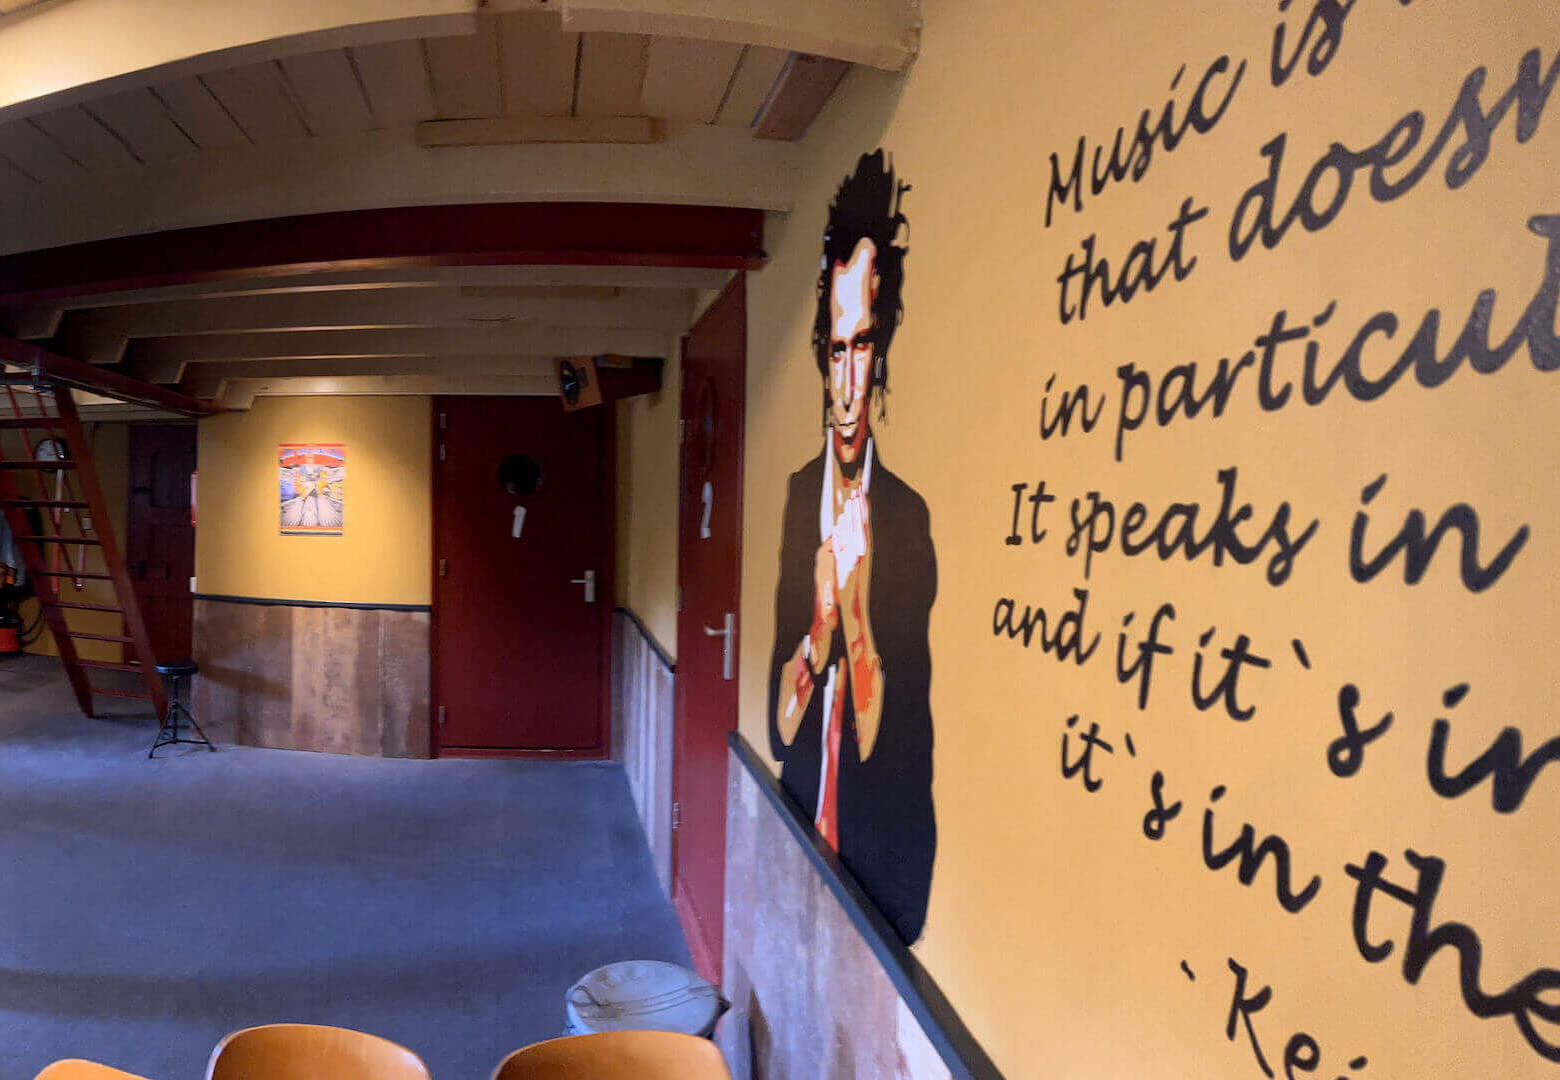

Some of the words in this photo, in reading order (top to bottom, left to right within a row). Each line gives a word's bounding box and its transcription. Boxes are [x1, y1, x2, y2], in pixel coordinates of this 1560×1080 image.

[1044, 55, 1246, 228] Music
[1271, 0, 1357, 88] is
[1057, 197, 1208, 325] that
[1040, 374, 1105, 441] in
[512, 505, 527, 538] 1
[700, 482, 713, 538] 2
[1005, 482, 1055, 546] It
[1065, 467, 1318, 587] speaks
[1350, 474, 1529, 593] in
[993, 588, 1100, 665] and
[1117, 604, 1175, 710] if
[1202, 785, 1321, 914] in
[1344, 849, 1560, 1064] the
